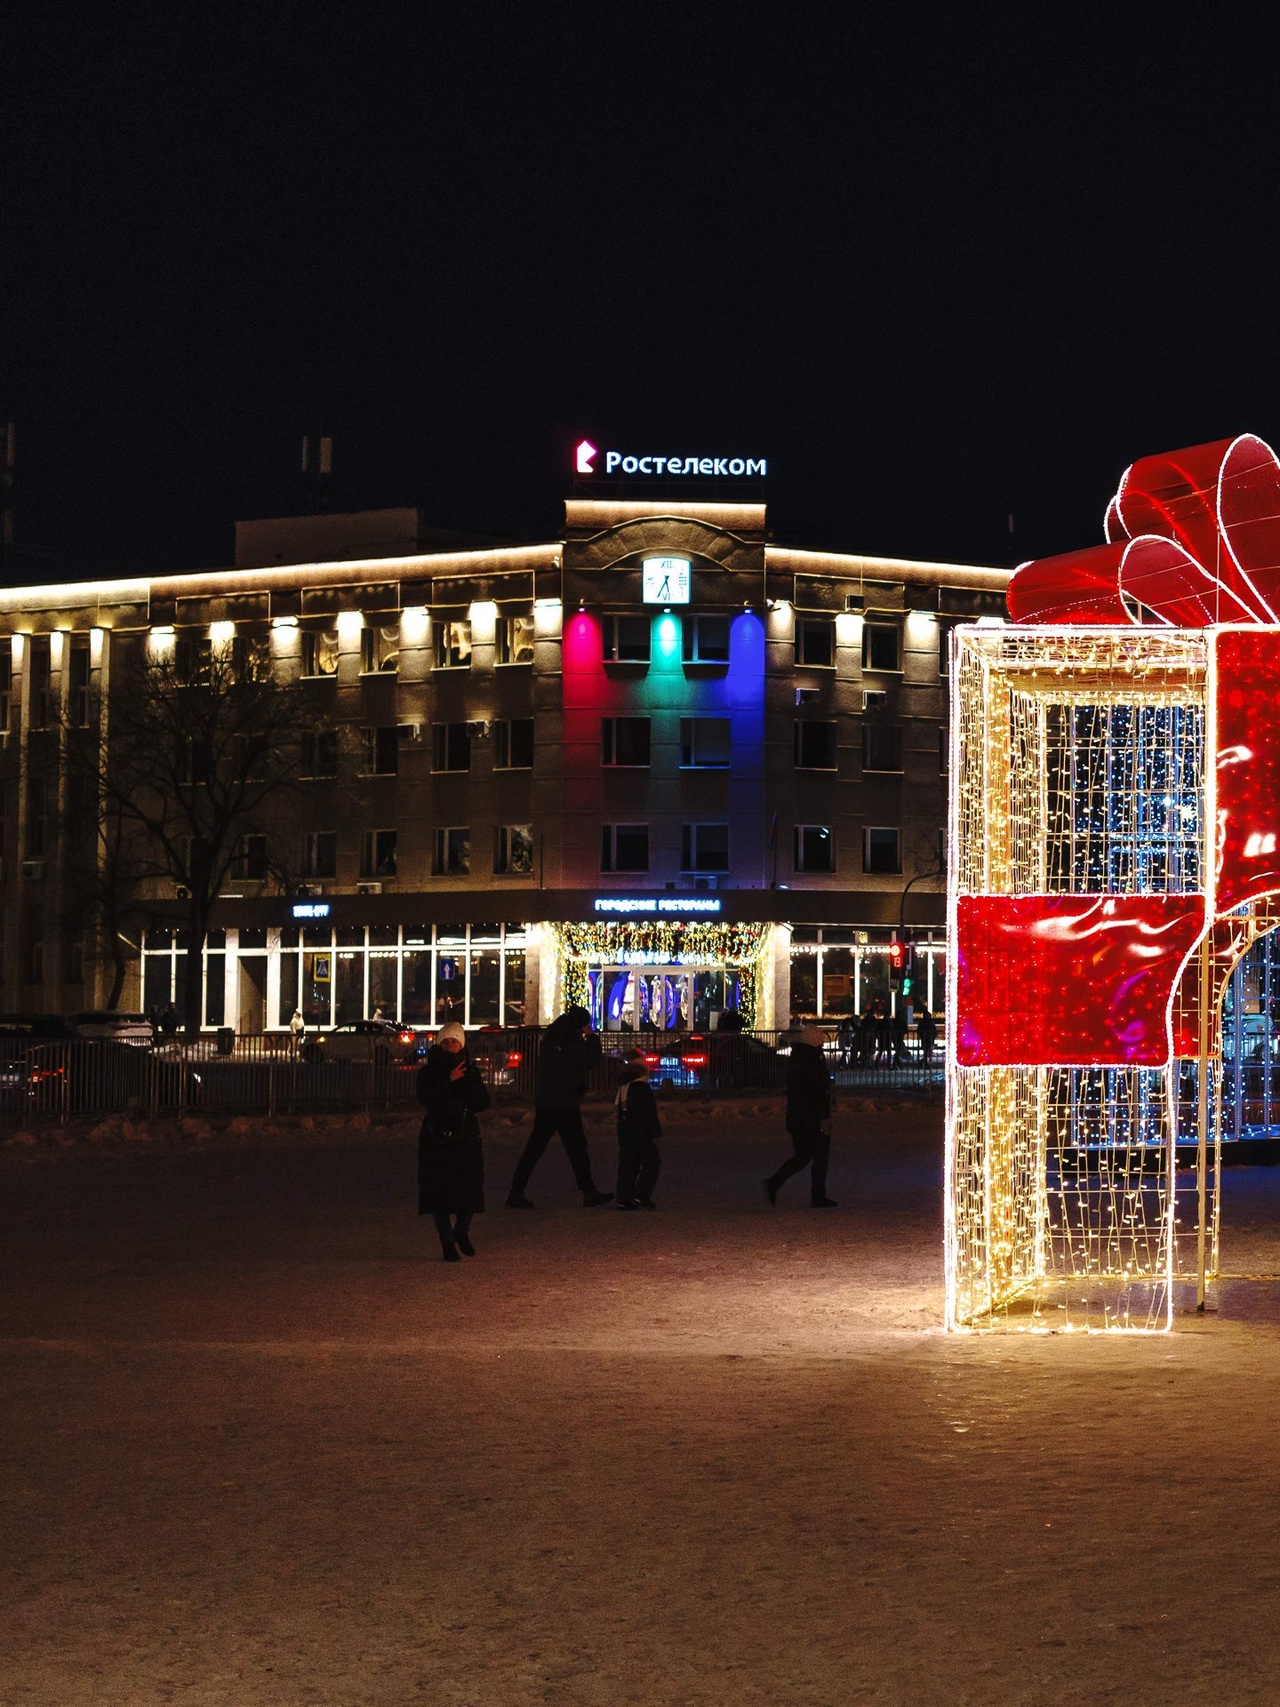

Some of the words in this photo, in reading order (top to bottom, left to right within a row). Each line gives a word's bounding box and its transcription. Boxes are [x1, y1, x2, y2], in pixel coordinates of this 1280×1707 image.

[606, 451, 767, 476] Ростелеком
[595, 899, 656, 912] ГОРОДСКИЕ
[658, 899, 720, 911] РЕСТОРАНЫ
